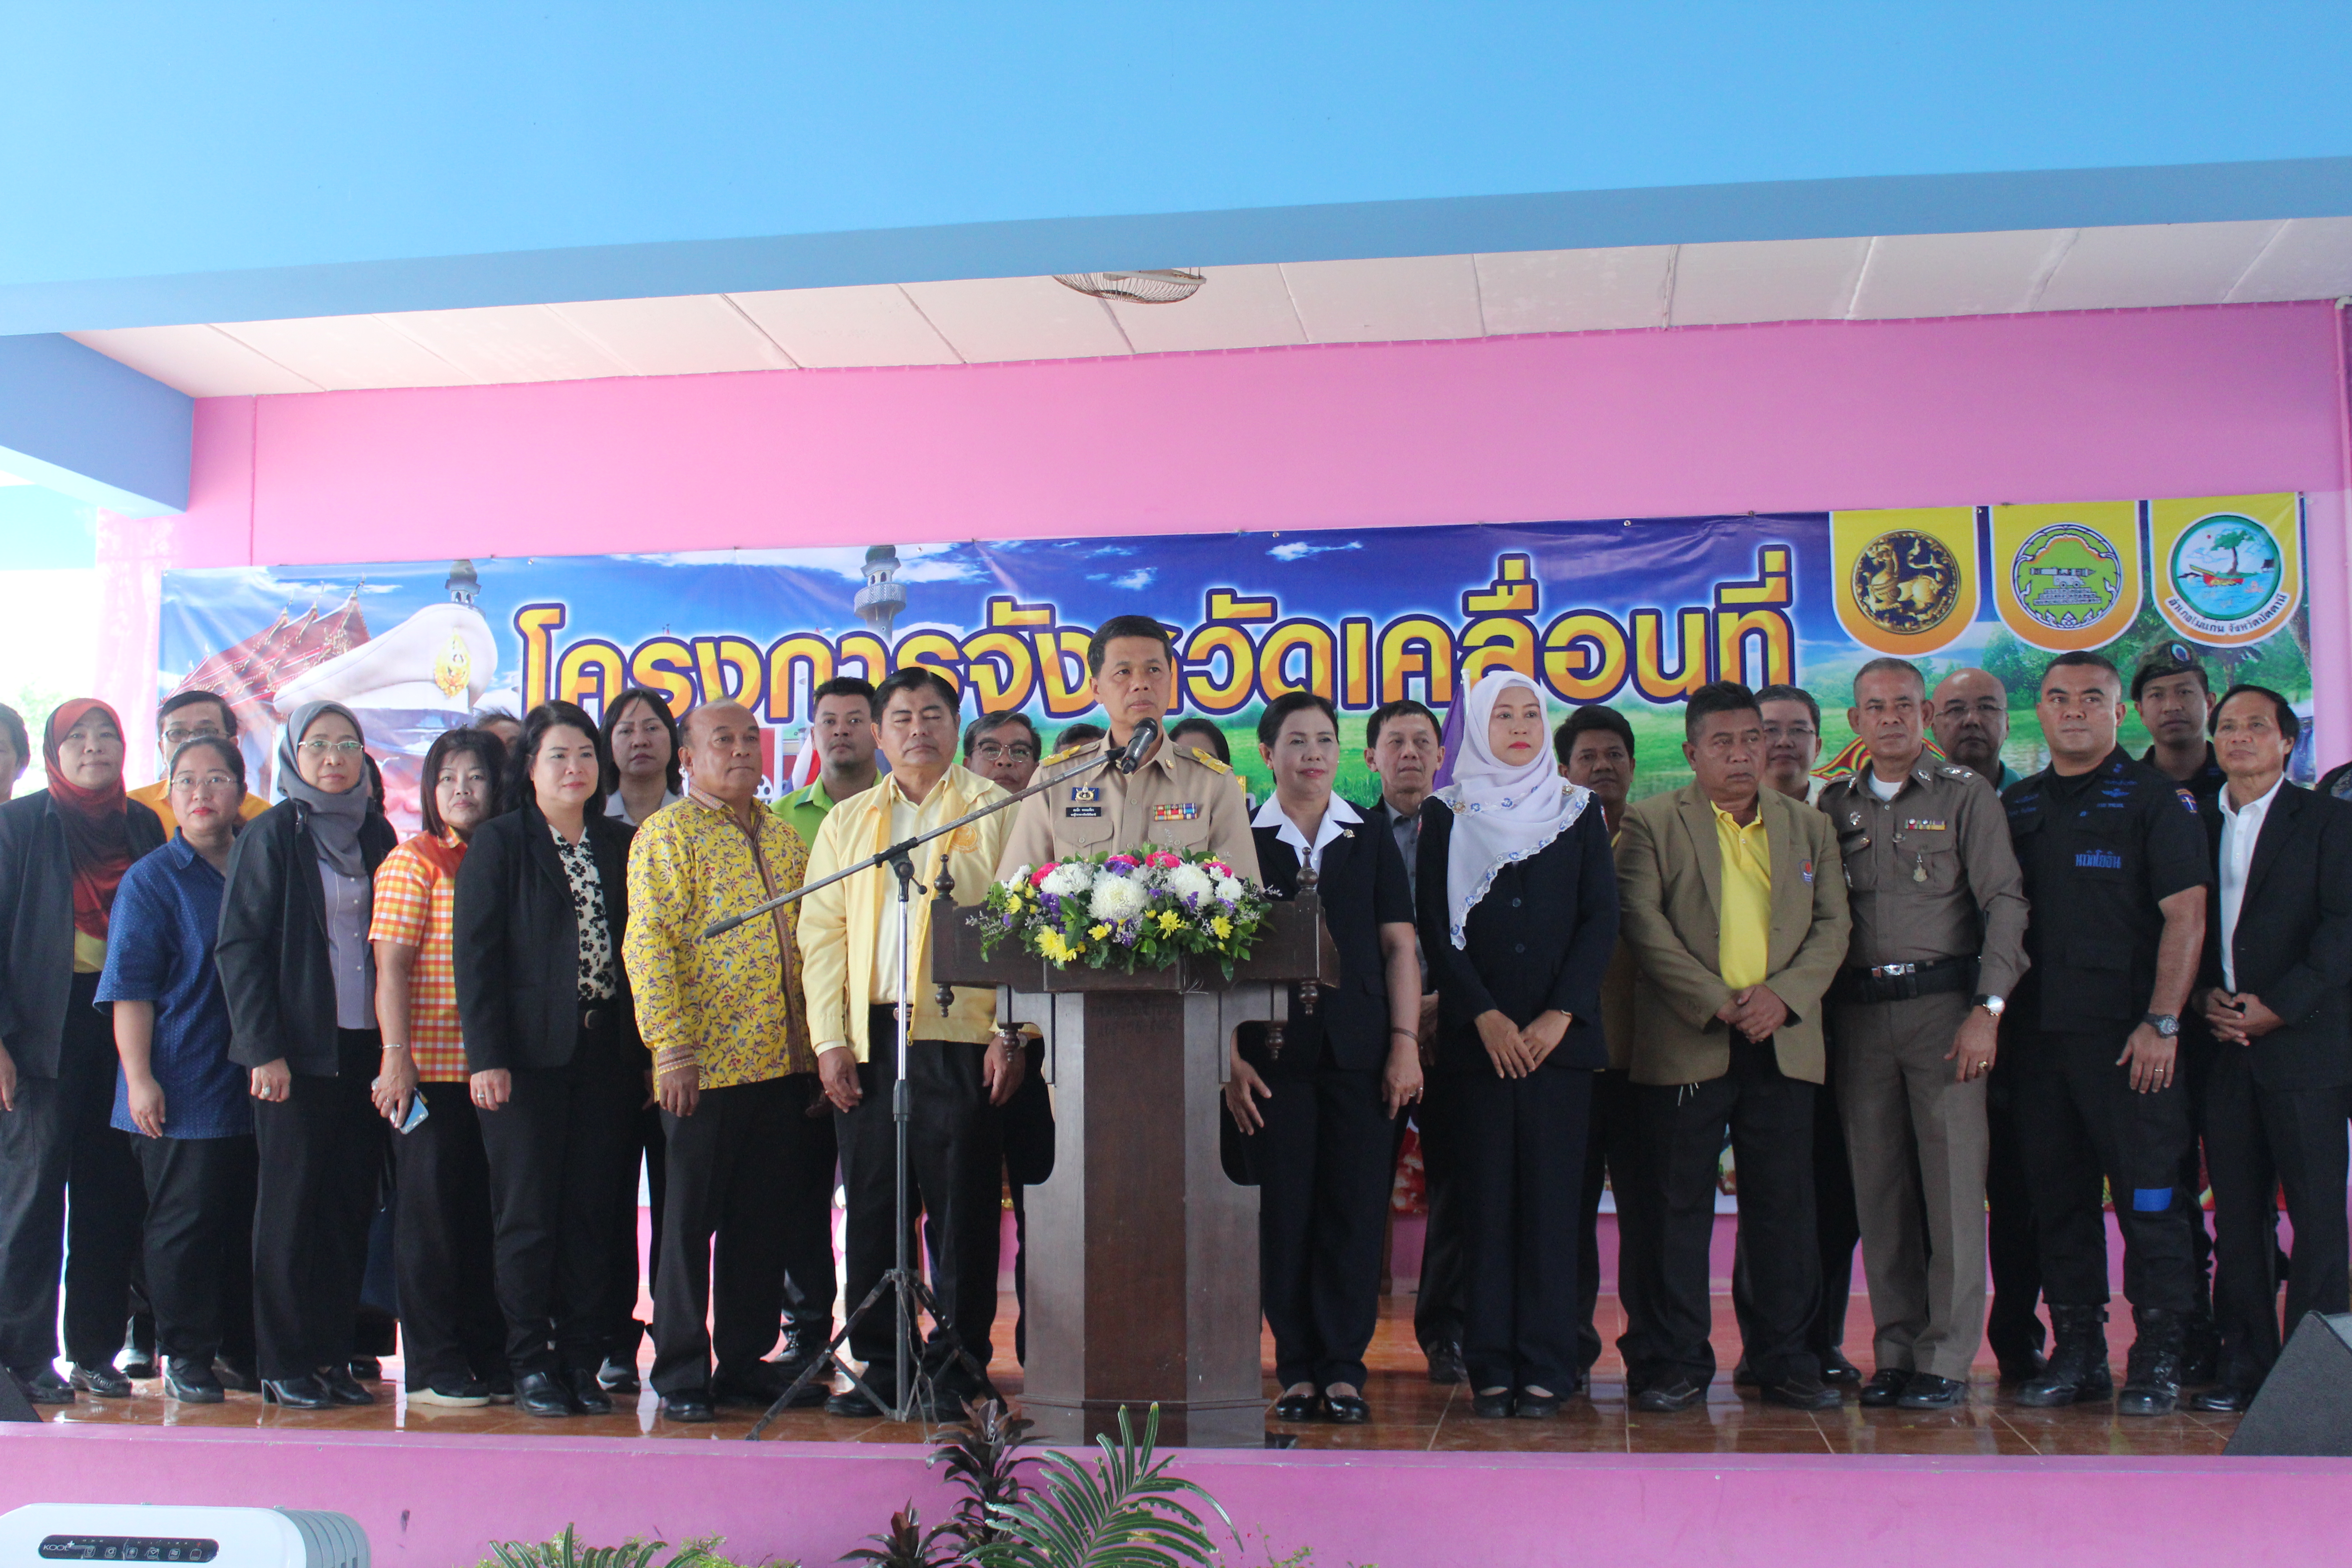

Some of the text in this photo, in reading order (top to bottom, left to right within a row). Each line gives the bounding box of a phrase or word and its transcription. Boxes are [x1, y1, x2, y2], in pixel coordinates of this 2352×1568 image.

[514, 544, 1795, 725] โครงการจังวัดเคลื่อนที่
[2228, 593, 2287, 632] จังหวัดปัตตานี
